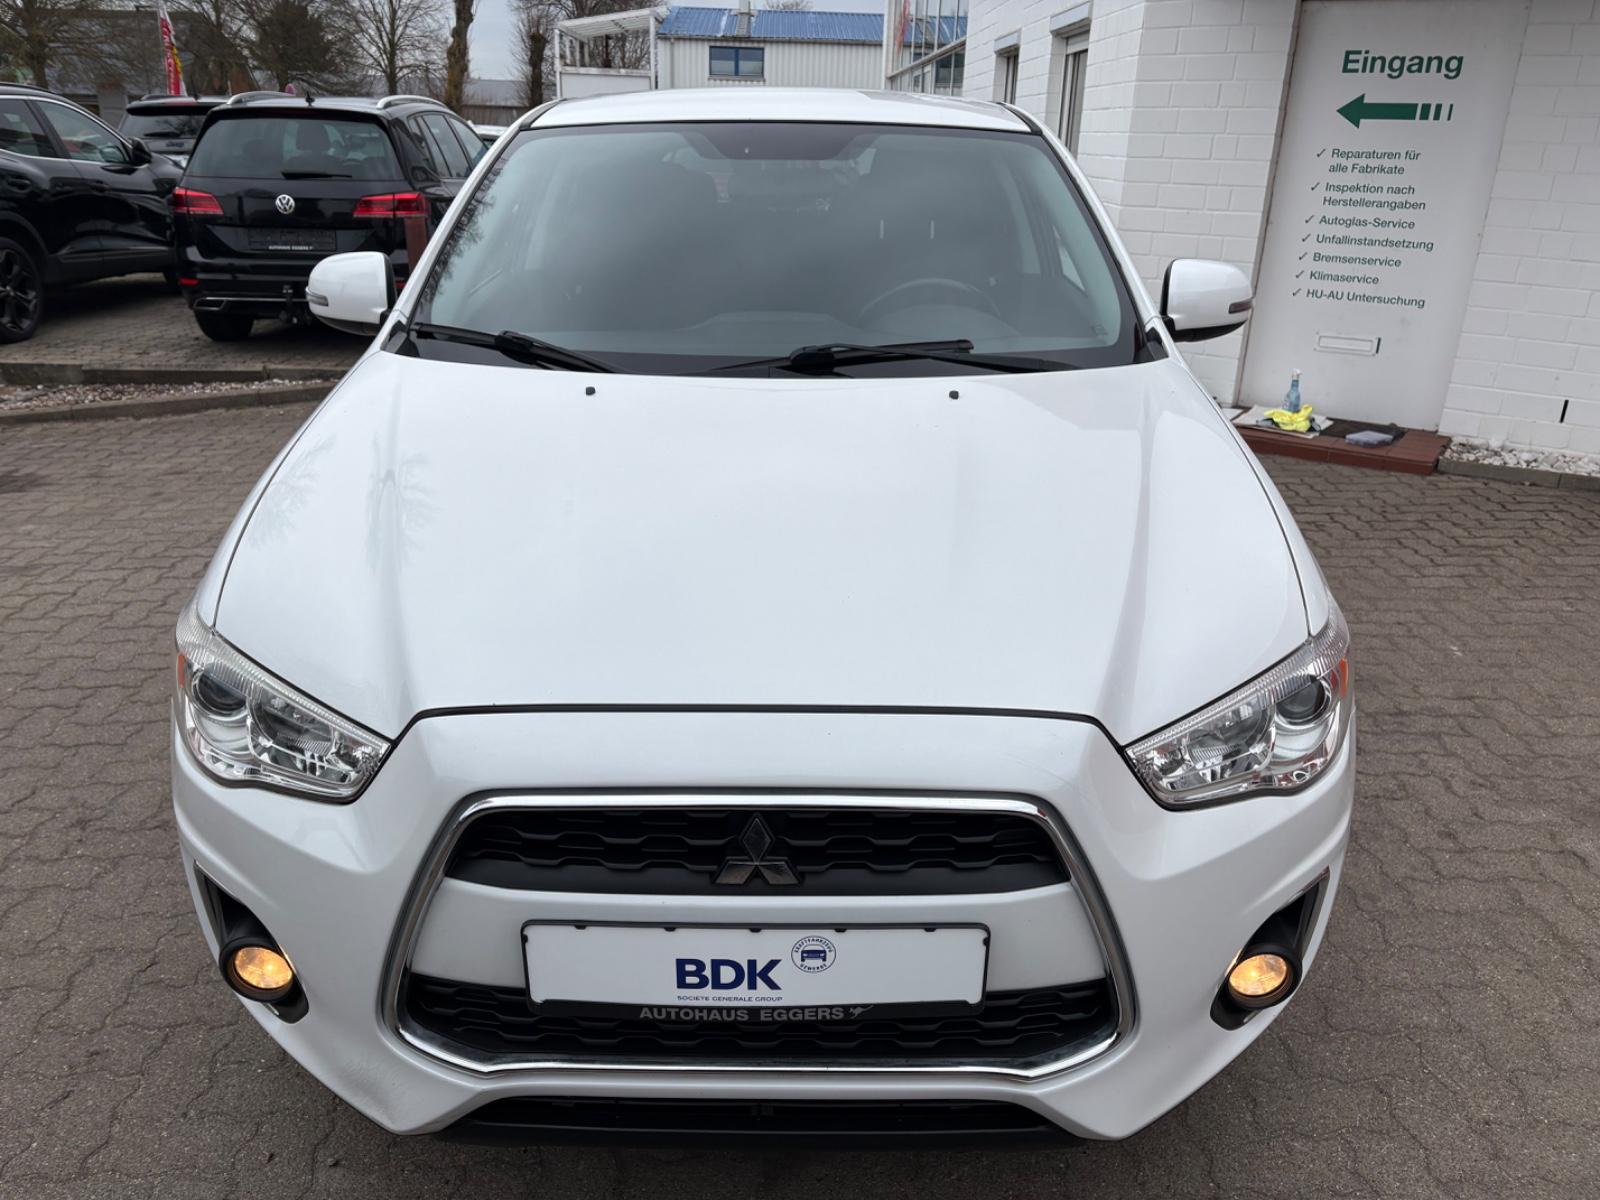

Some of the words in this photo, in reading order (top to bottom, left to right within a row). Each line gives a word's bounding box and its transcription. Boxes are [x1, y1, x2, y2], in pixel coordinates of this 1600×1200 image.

[1341, 50, 1464, 79] Eingang
[1331, 149, 1401, 163] Reparaturen
[1404, 150, 1421, 161] für
[1328, 163, 1348, 173] alle
[1351, 164, 1405, 175] Fabrikate
[1325, 182, 1384, 197] Inspektion
[1386, 185, 1415, 195] nach
[275, 194, 296, 215] VW
[1322, 196, 1426, 212] Herstellerangaben
[1318, 215, 1416, 230] Autoglas-Service
[1316, 234, 1434, 252] Unfallinstandsetzung
[1312, 253, 1402, 268] Bremsenservice
[1309, 270, 1380, 285] Klimaservice
[1306, 289, 1344, 301] HU-AU
[1347, 292, 1426, 309] Untersuchung
[675, 958, 783, 991] BDK
[639, 1007, 750, 1021] AUTOHAUS
[760, 1007, 844, 1021] EGGERS
